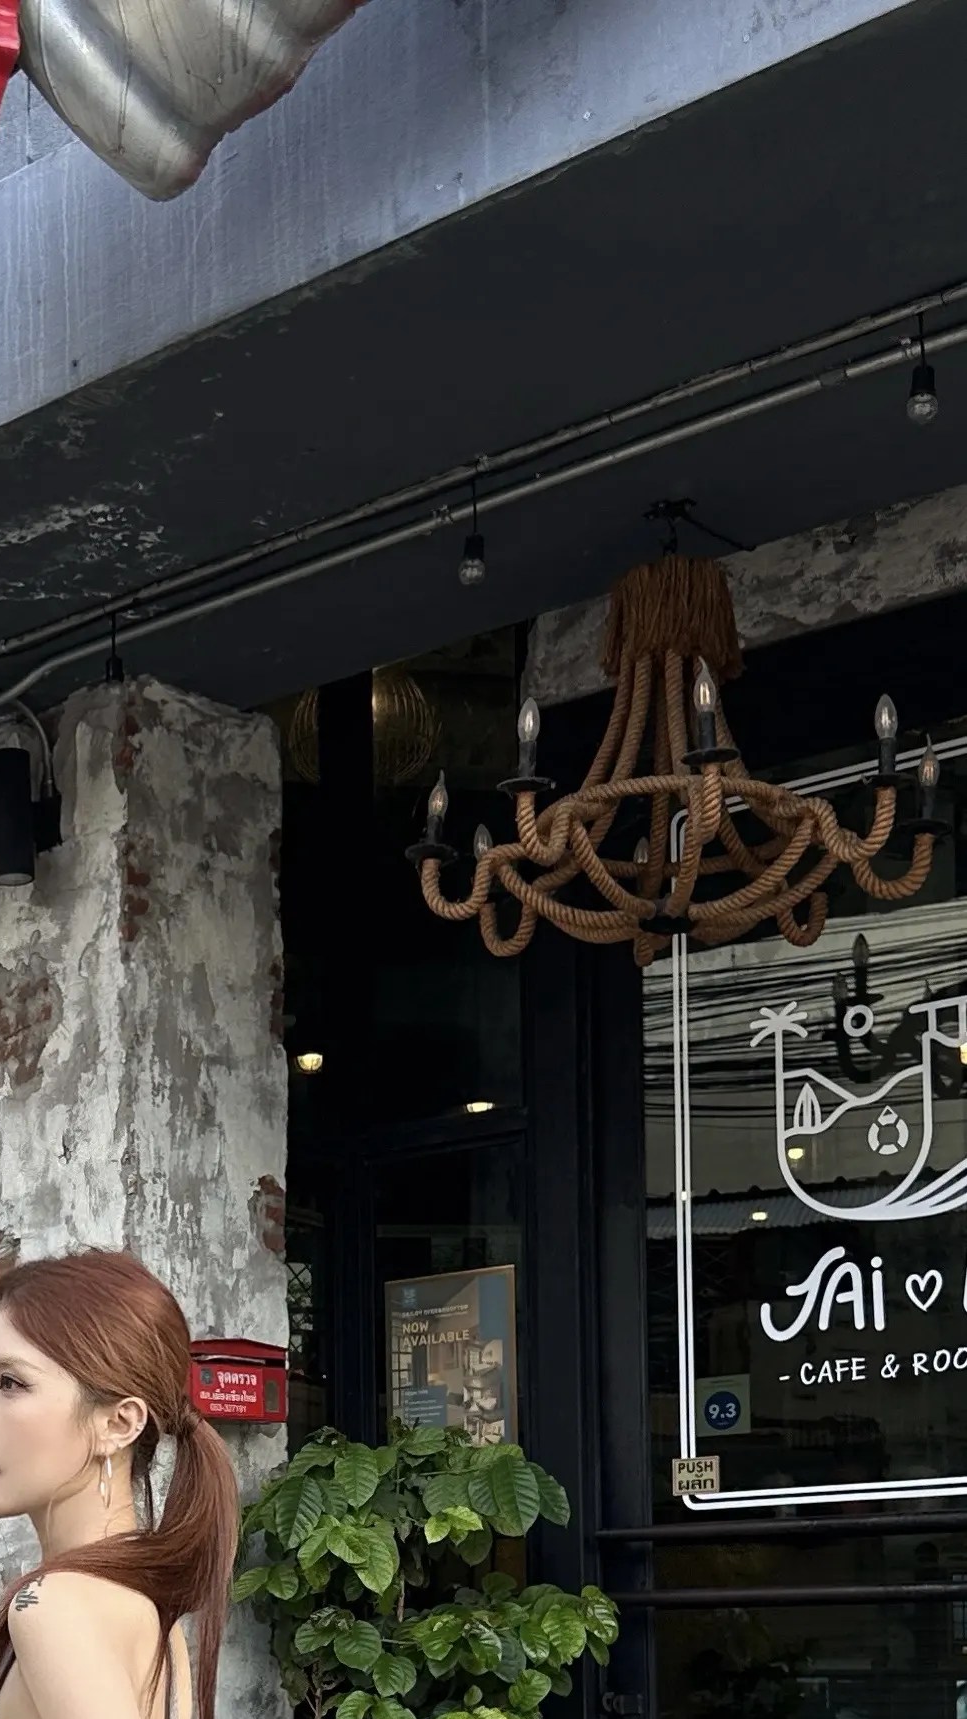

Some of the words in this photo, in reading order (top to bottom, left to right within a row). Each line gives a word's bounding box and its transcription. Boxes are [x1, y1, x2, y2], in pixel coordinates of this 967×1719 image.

[402, 1320, 429, 1335] NOW
[402, 1329, 470, 1348] AVAILABLE
[800, 1357, 866, 1385] CAFE
[881, 1353, 900, 1379] &
[217, 1371, 257, 1388] จุดตรวจ
[708, 1402, 737, 1419] 9.3
[678, 1461, 713, 1474] PUSH
[678, 1473, 715, 1491] ผลัก
